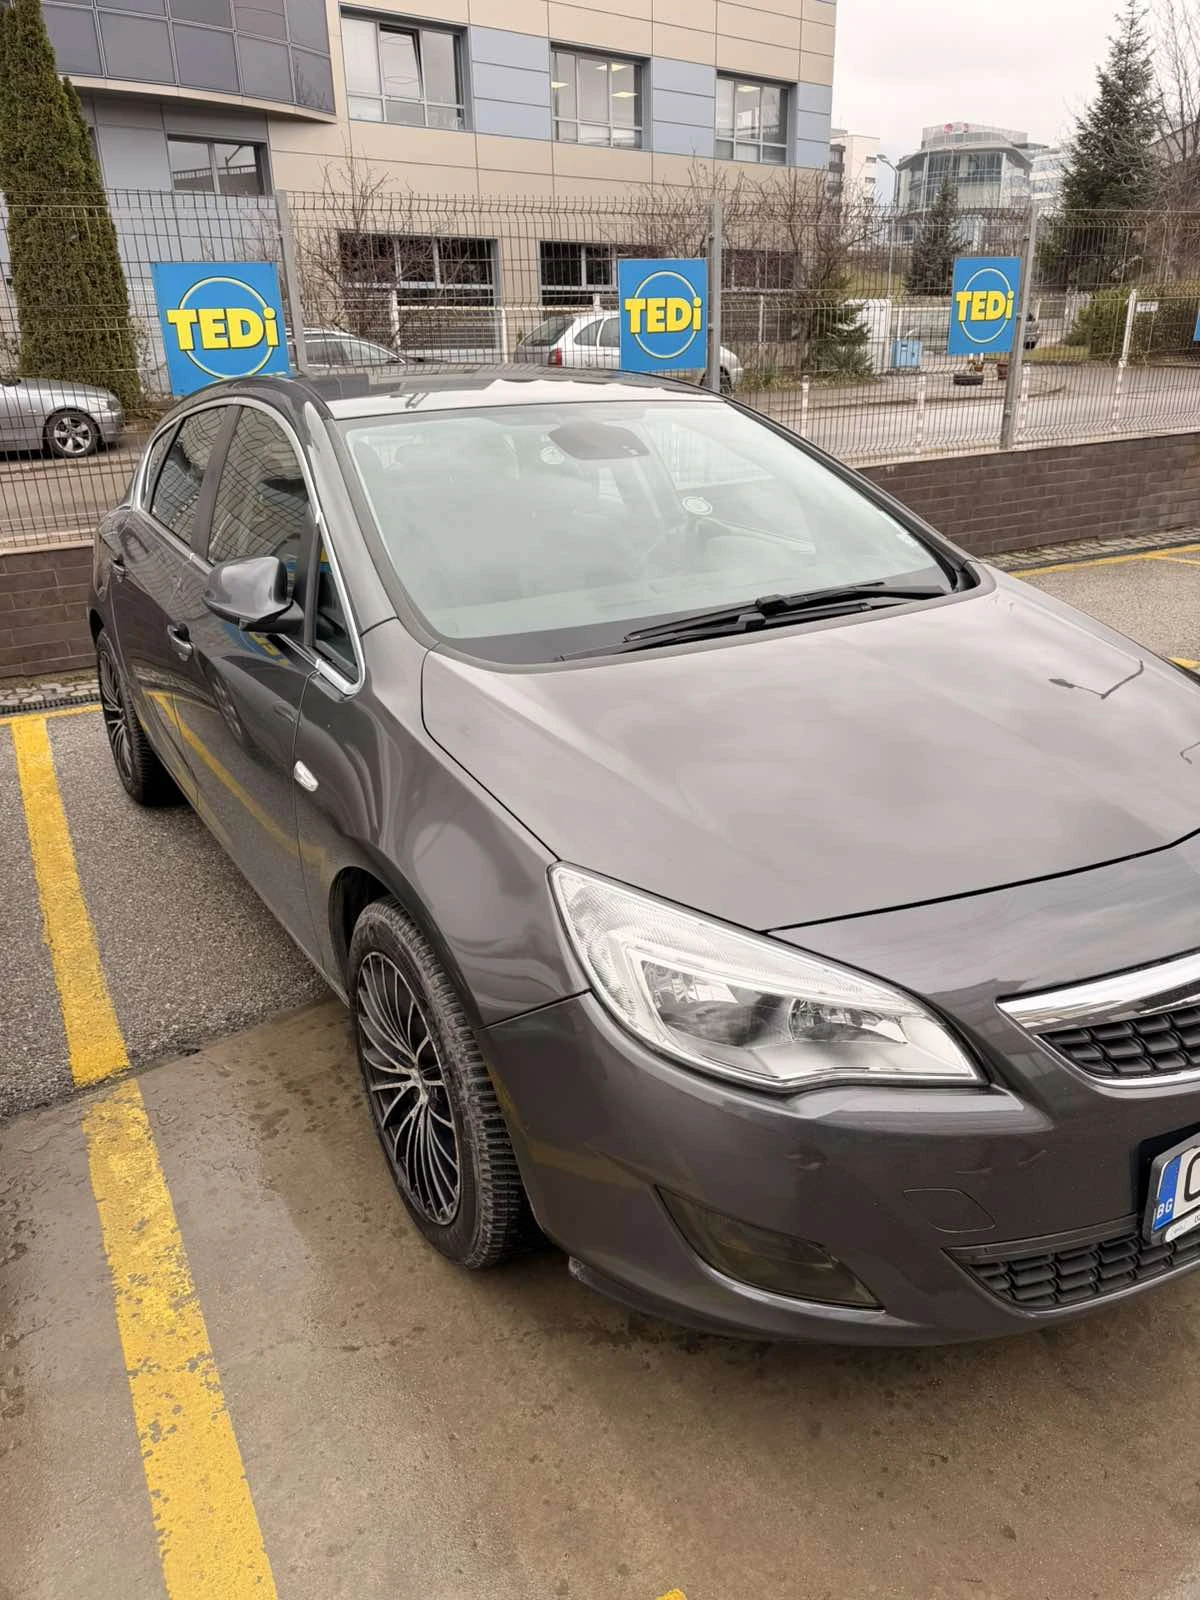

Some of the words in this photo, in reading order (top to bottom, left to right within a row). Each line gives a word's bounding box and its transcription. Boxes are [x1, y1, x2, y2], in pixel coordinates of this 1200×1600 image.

[624, 297, 702, 334] TEDi
[956, 290, 1014, 322] TEDi
[166, 307, 279, 351] TEDi
[1156, 1198, 1173, 1219] BG
